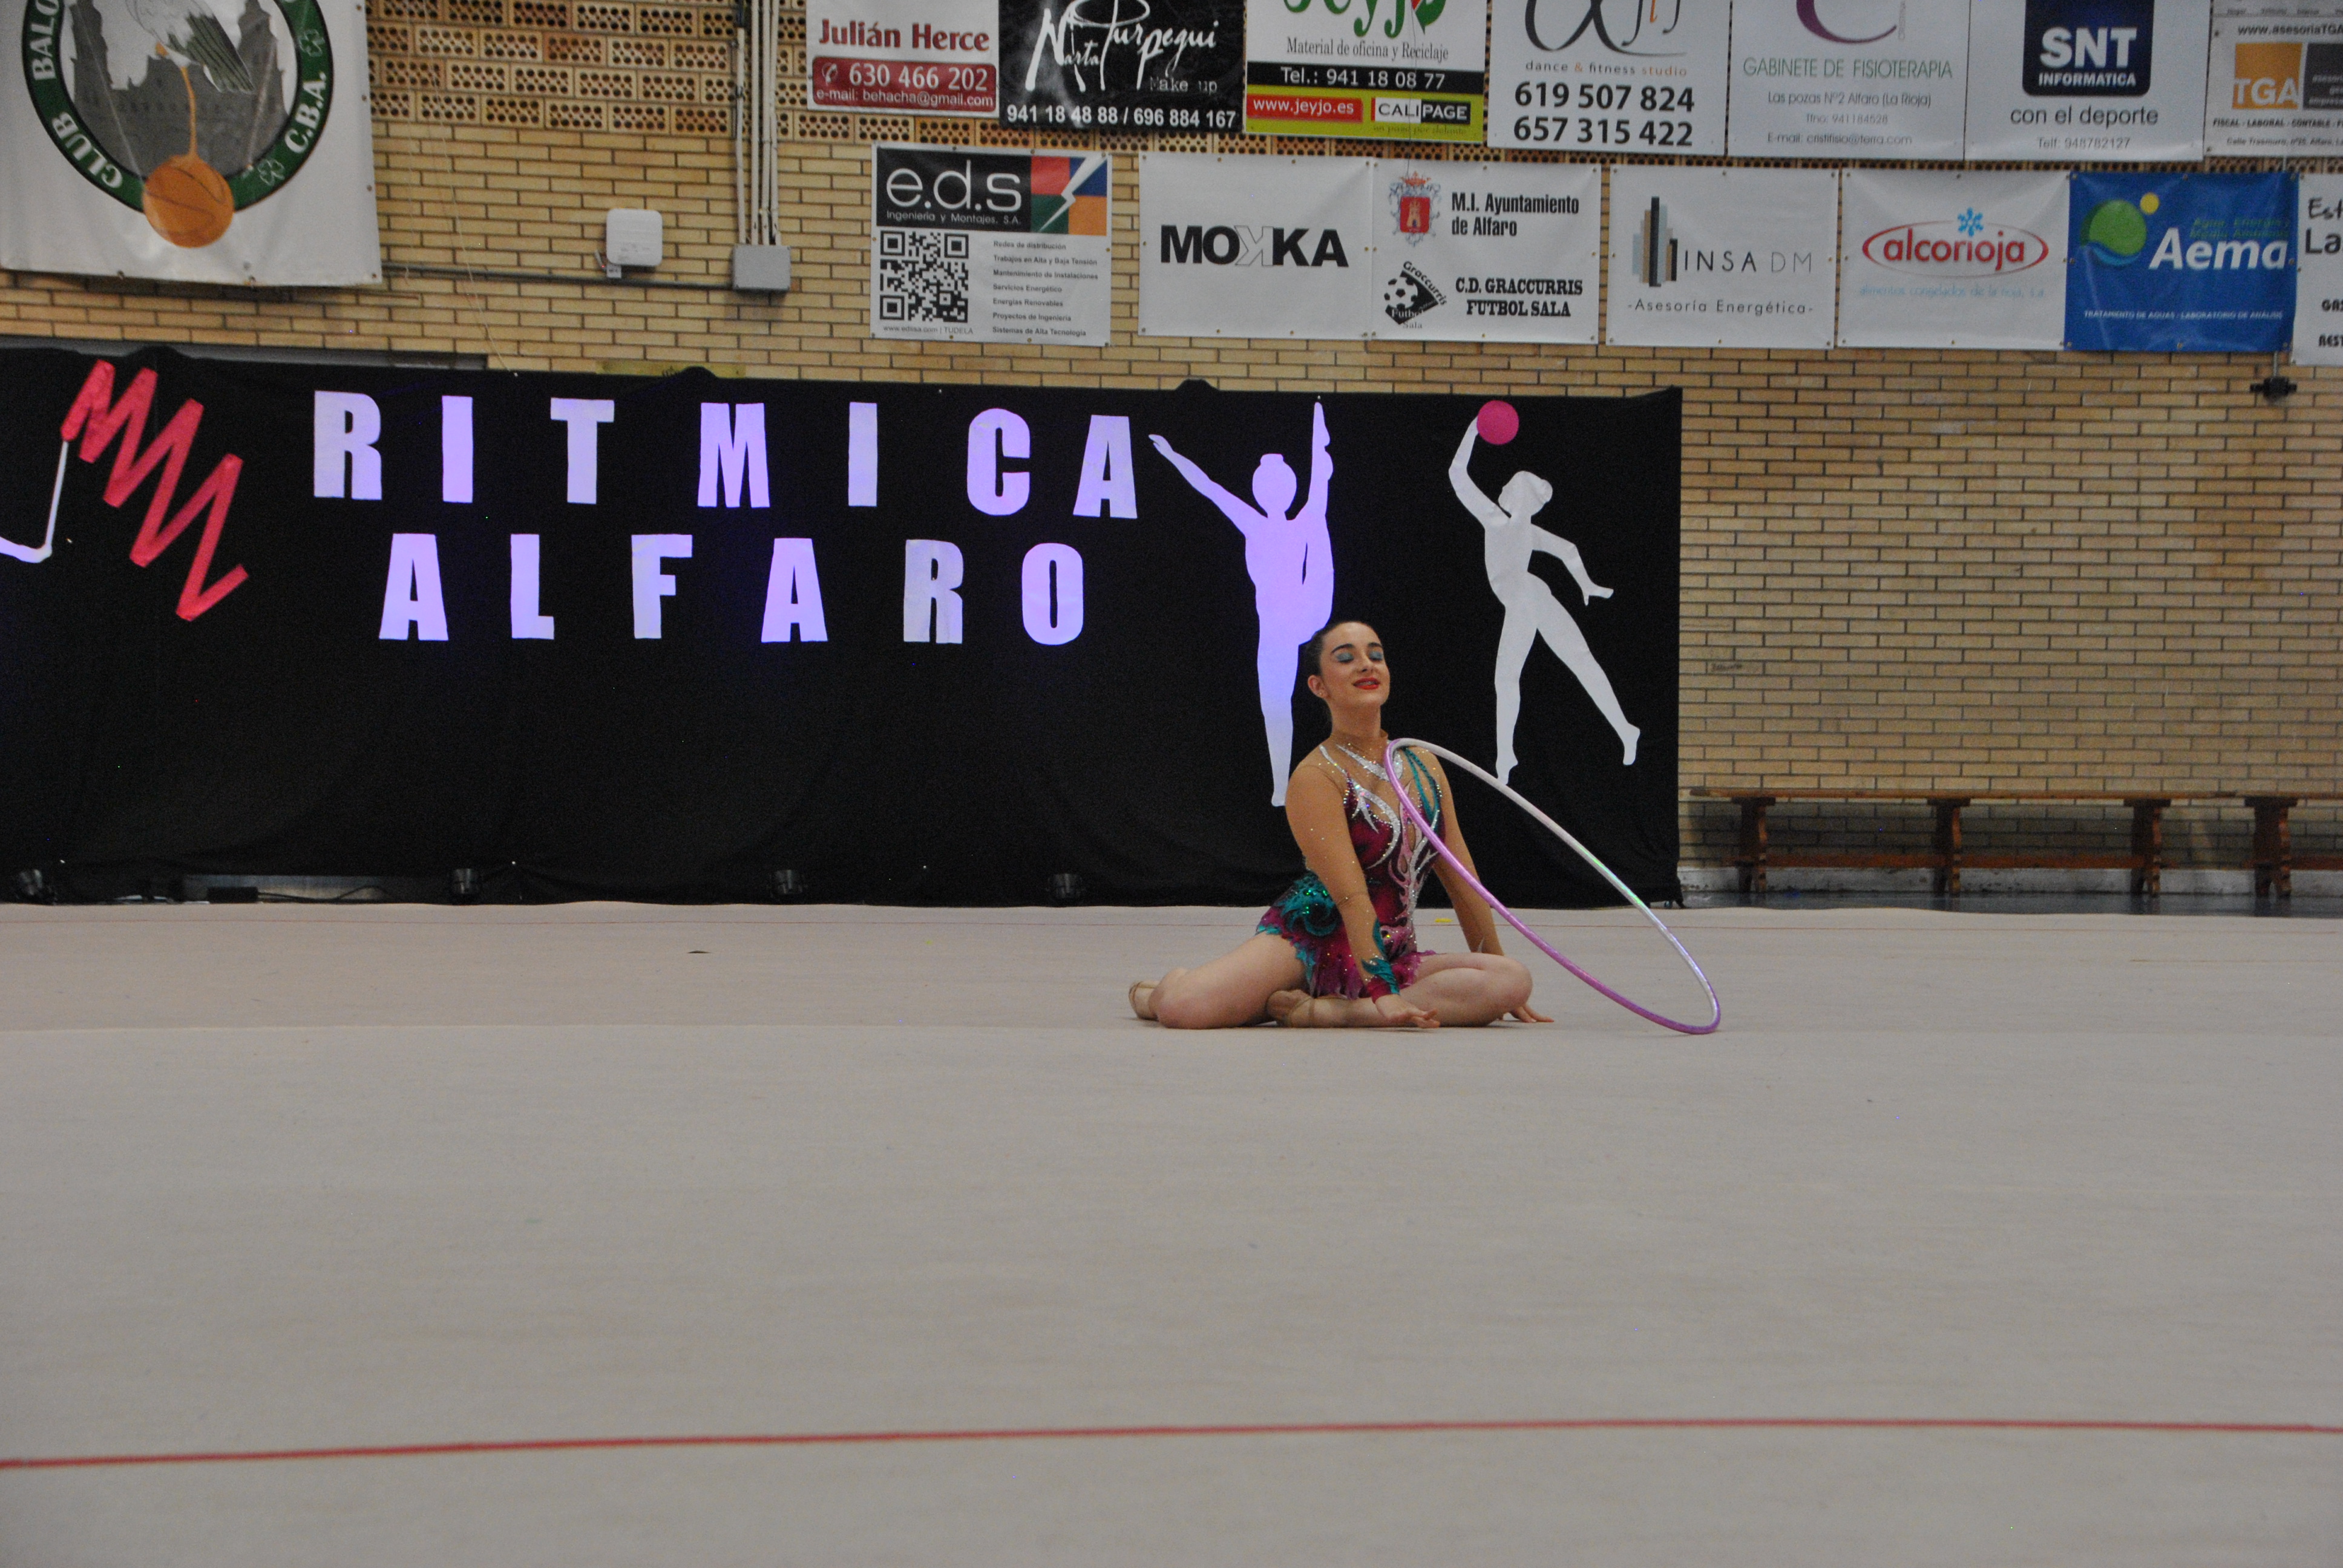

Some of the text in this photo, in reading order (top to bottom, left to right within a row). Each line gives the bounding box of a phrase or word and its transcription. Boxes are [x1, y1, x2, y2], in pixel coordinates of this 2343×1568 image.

[819, 19, 989, 51] Julián Herce
[1286, 36, 1449, 63] Material de oficina y Reciclaje
[2040, 27, 2137, 68] SNT
[850, 63, 988, 91] 630 466 202
[1280, 67, 1445, 90] Tel.: 941 18 08 77
[1526, 61, 1568, 72] dance
[1589, 63, 1635, 74] fitness
[1642, 65, 1687, 76] studio
[1743, 57, 1952, 79] GABINETE DE FISIOTERAPIA
[2039, 72, 2136, 87] INFORMATICA
[817, 88, 858, 101] e-mail:
[1198, 80, 1217, 94] up
[1515, 81, 1694, 112] 619 507 824
[1768, 91, 1785, 103] Las
[1789, 94, 1820, 105] pozas
[1848, 92, 1879, 105] Alfaro
[2234, 77, 2299, 106] TGA
[285, 71, 326, 154] C.B.A.
[1007, 105, 1037, 122] 941
[1046, 105, 1065, 122] 18
[1071, 106, 1091, 123] 48
[1098, 106, 1118, 123] 88
[1134, 108, 1164, 126] 696
[1170, 109, 1200, 127] 884
[1207, 110, 1236, 128] 167
[1253, 99, 1354, 115] www.jeyjo.es
[2011, 104, 2158, 129] con el deporte
[1514, 116, 1693, 146] 657 315 422
[52, 111, 122, 188] CLUB
[886, 160, 1021, 212] e.d.s
[1452, 192, 1579, 215] M.I. Ayuntamiento
[940, 214, 946, 223] y
[1452, 217, 1517, 237] de Alfaro
[994, 255, 1022, 263] Trabajos
[1884, 227, 2025, 272] alcorioja
[2148, 227, 2289, 270] Aema
[1685, 250, 1812, 273] INSA DM
[1456, 277, 1583, 295] C.D. GRACCURRIS
[1467, 299, 1571, 317] FUTBOL SALA
